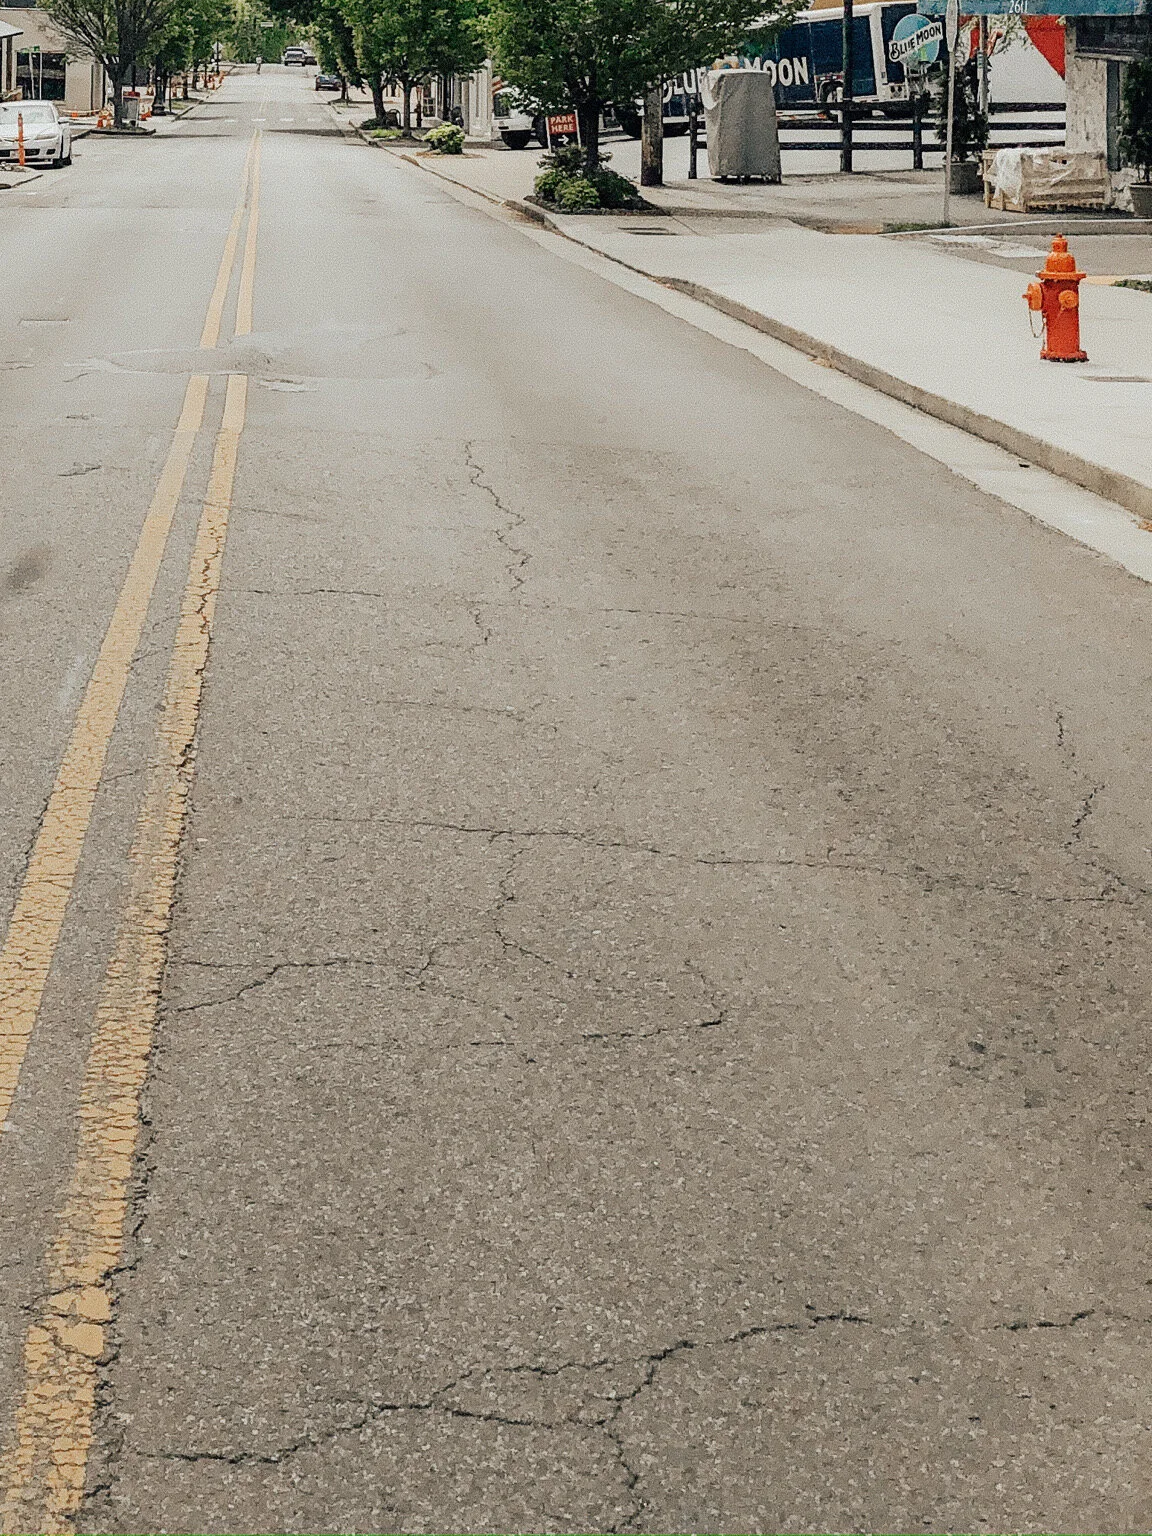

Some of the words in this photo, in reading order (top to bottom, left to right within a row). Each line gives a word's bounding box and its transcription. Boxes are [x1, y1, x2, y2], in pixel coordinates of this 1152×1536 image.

[890, 37, 915, 60] BLUE
[915, 24, 942, 45] MOON
[550, 115, 574, 125] PARK
[551, 124, 574, 133] HERE
